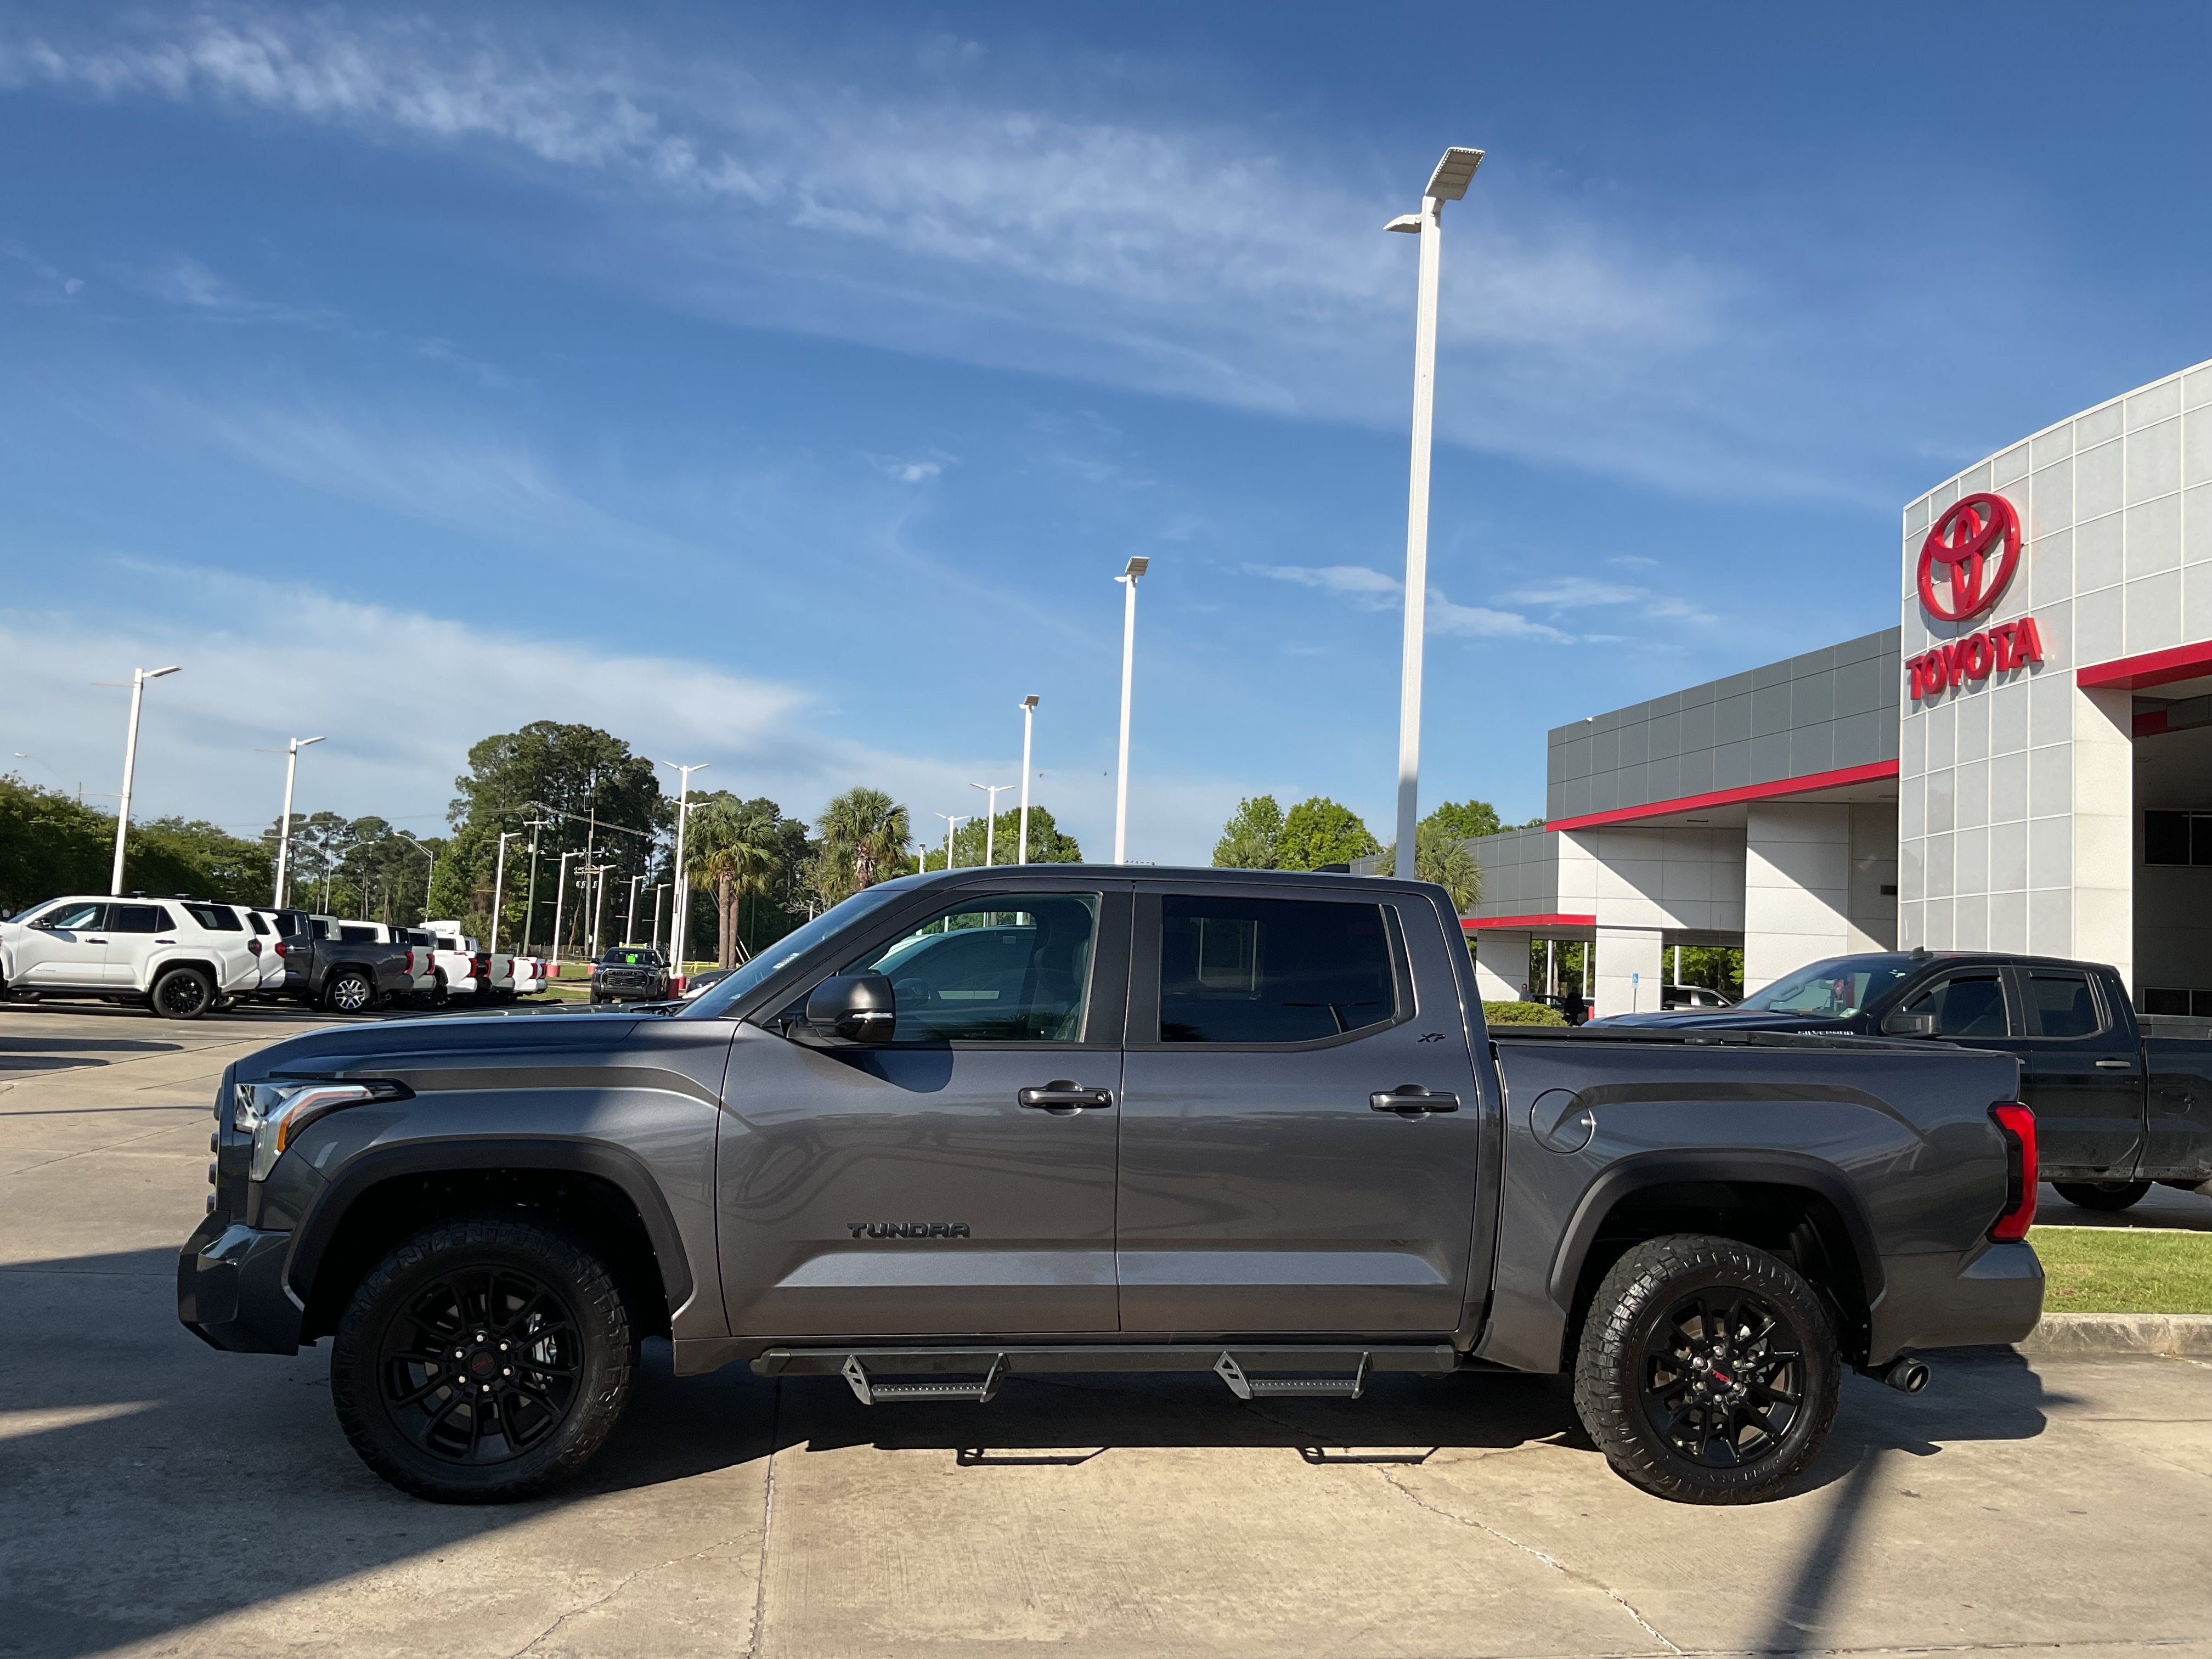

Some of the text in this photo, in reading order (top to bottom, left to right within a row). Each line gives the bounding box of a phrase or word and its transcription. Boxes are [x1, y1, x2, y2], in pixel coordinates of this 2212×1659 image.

[1906, 618, 2044, 699] TOYOTA
[847, 1223, 970, 1238] TUNDRA
[1712, 1369, 1729, 1383] TRD
